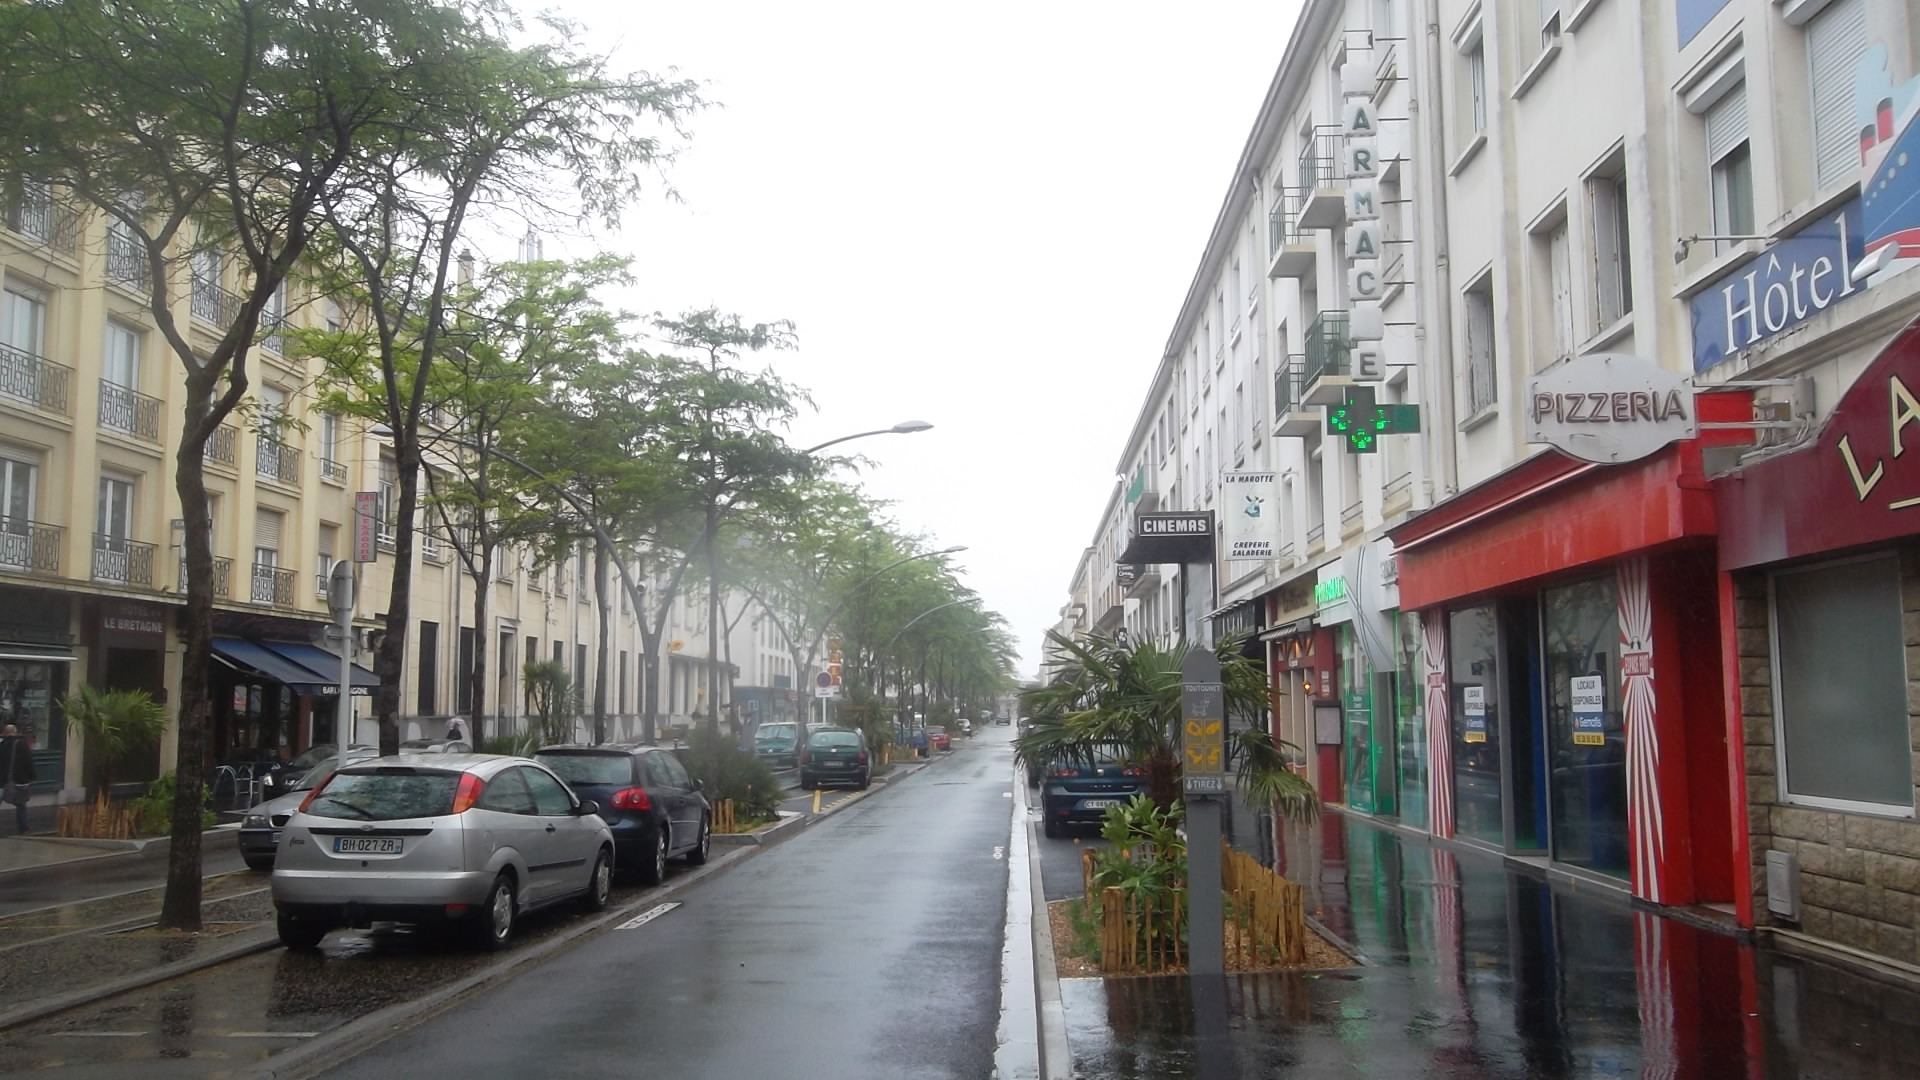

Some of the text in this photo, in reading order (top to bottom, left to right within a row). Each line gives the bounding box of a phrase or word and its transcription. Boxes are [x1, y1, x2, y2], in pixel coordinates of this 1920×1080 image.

[1722, 211, 1855, 355] Hôtel
[1533, 390, 1688, 424] PIZZERIA
[1238, 475, 1275, 483] MAROTTE
[1143, 519, 1207, 533] CINEMAS
[1233, 541, 1270, 549] CREPERIE
[1232, 549, 1273, 557] SALADERIE
[104, 618, 162, 632] LE BRETAGNE
[1193, 780, 1216, 789] TIREZ
